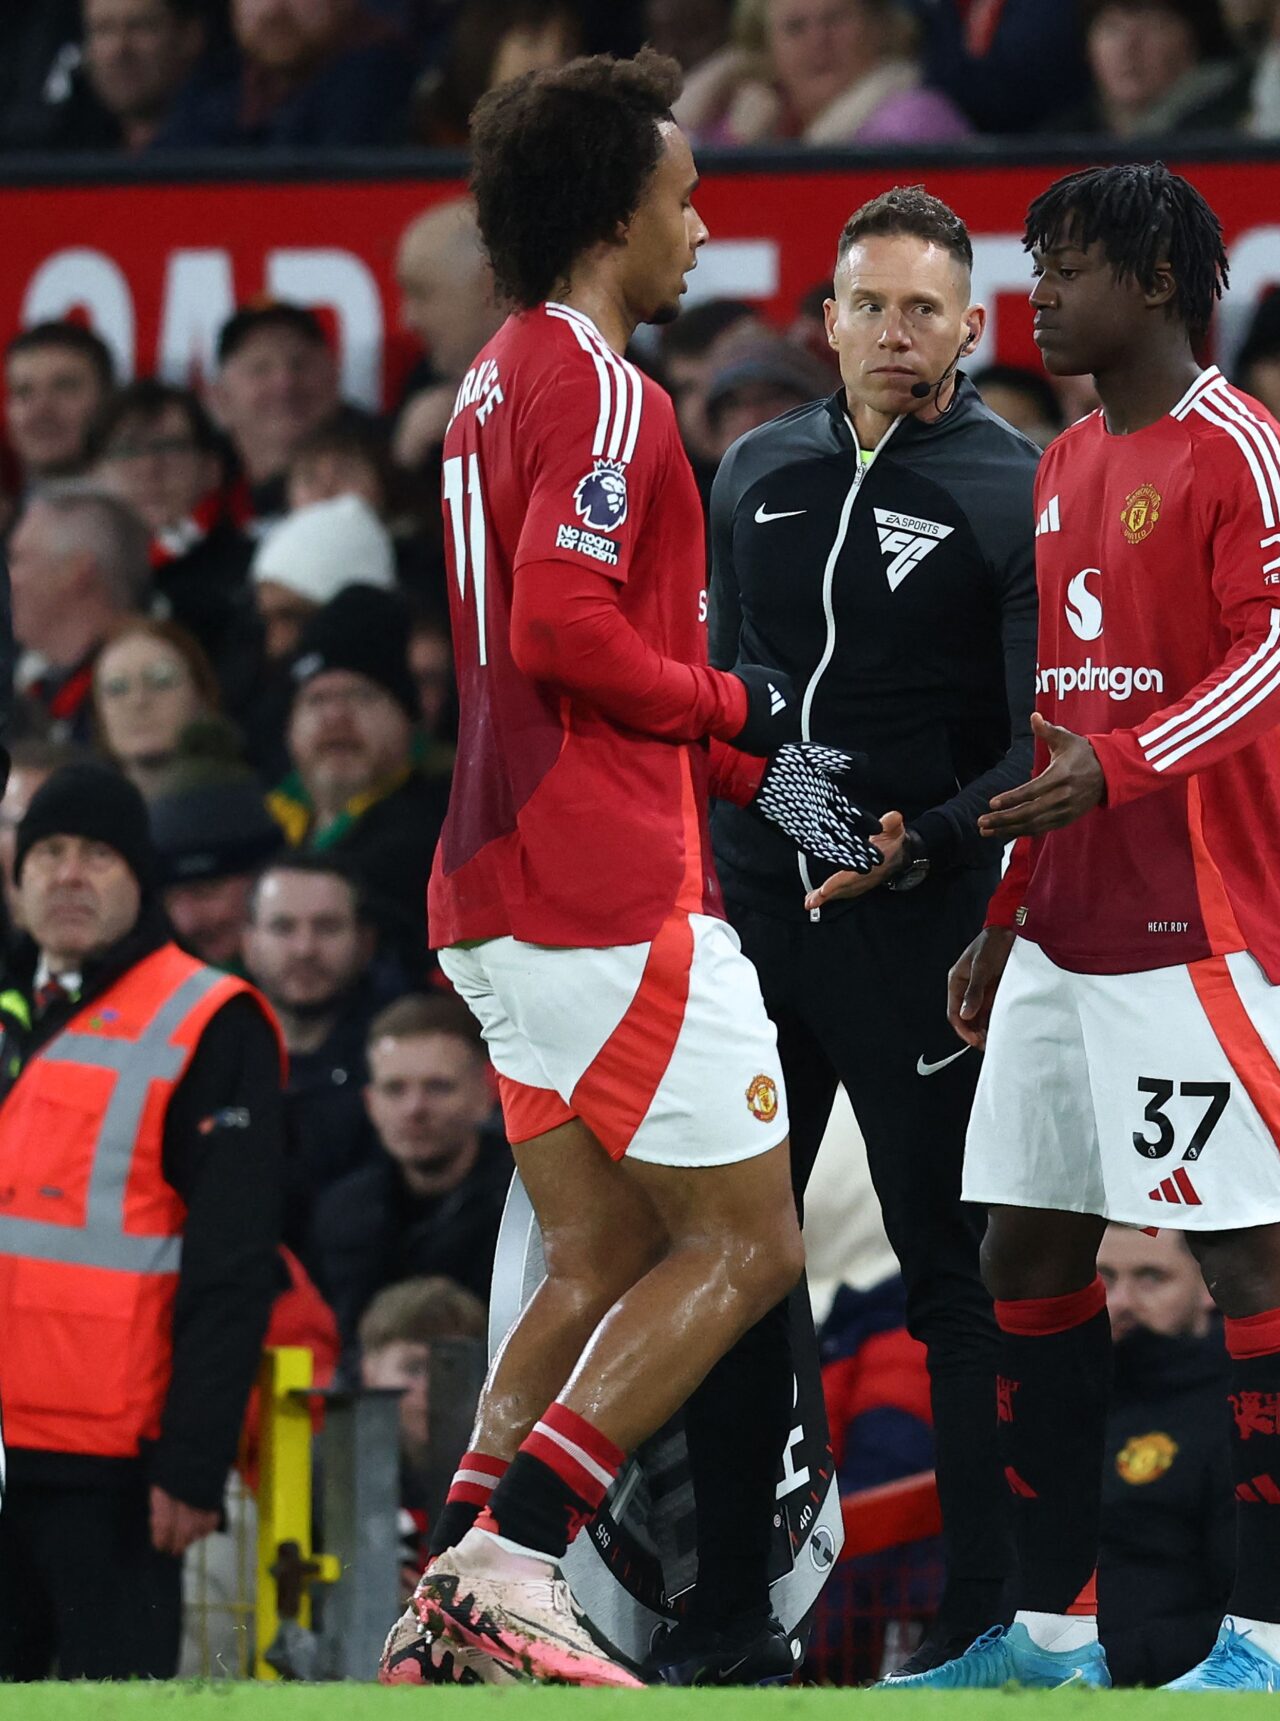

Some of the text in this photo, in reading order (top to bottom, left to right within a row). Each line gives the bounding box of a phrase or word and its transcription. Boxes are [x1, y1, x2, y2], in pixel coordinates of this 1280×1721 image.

[557, 523, 616, 553] No room
[901, 517, 940, 535] SPORTS
[443, 452, 487, 666] 11
[555, 535, 619, 566] for racism
[1147, 921, 1189, 933] HEAT.RDY
[1132, 1075, 1231, 1161] 37
[799, 1504, 813, 1531] 40
